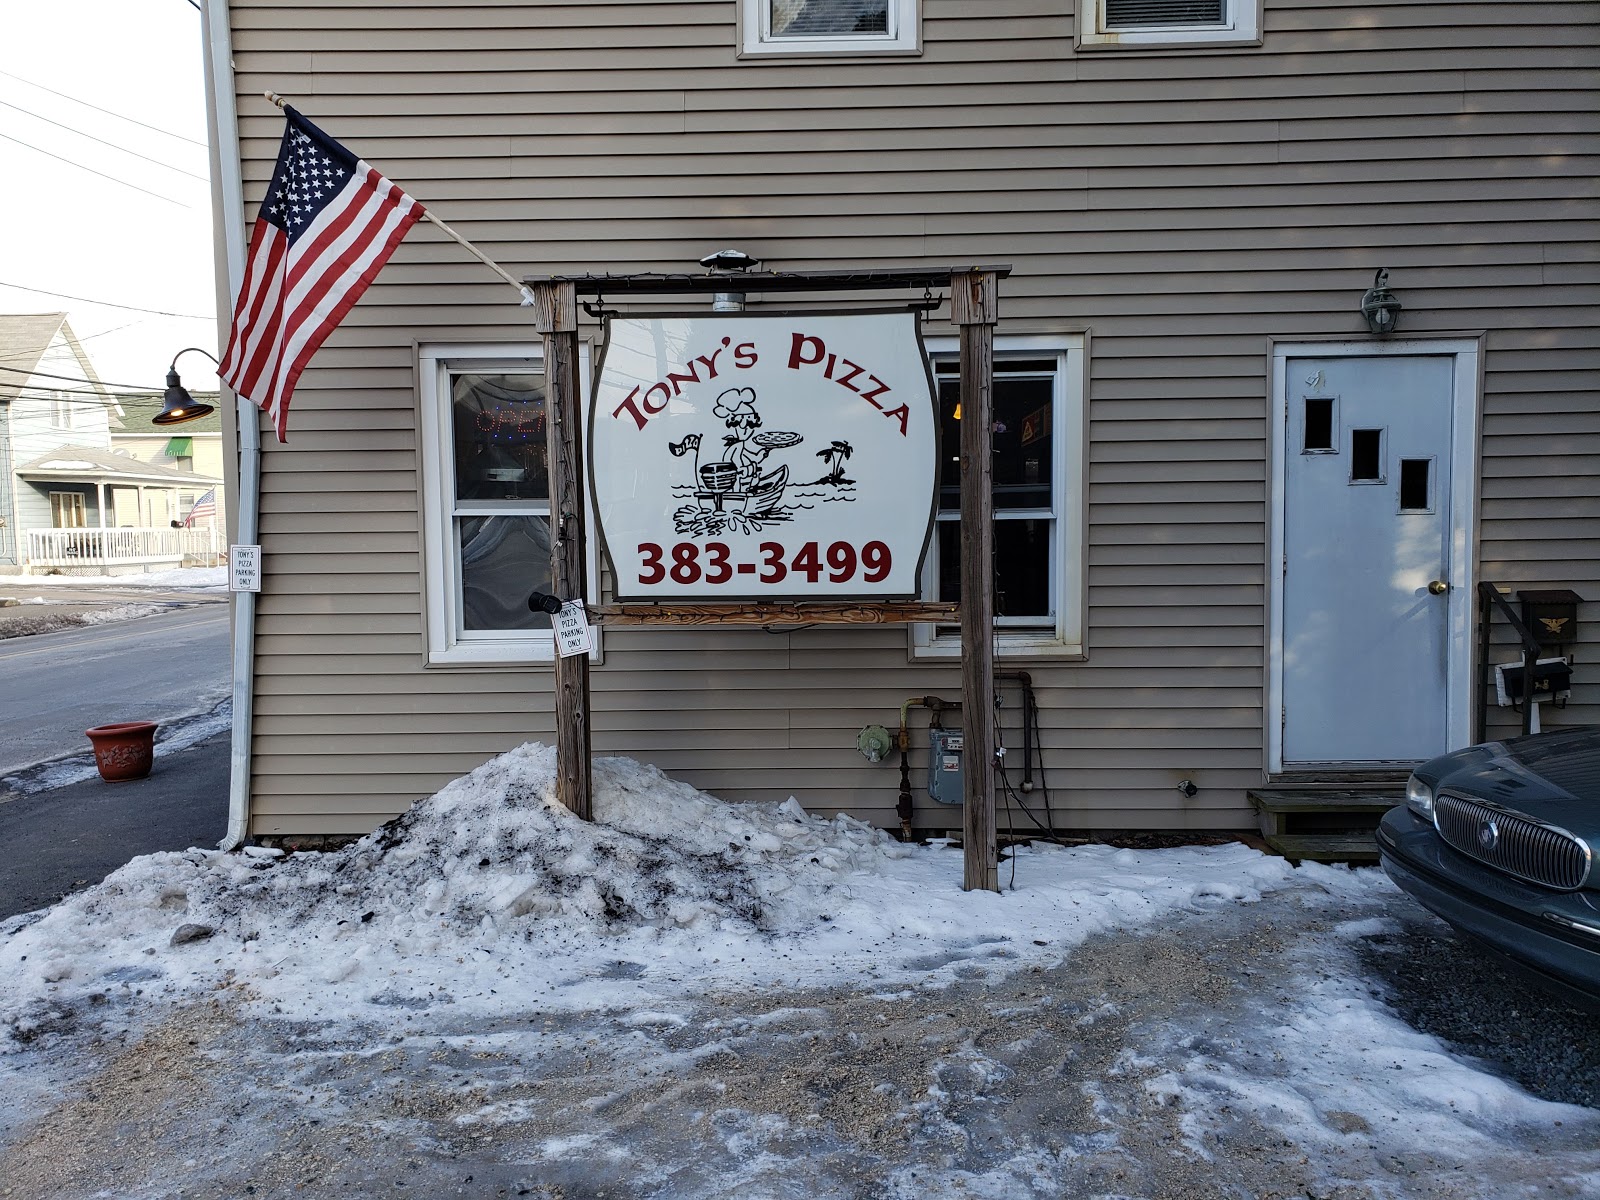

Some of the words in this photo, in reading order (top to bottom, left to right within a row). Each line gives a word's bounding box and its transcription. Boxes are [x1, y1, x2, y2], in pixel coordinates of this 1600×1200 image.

[787, 332, 910, 437] PIZZA
[476, 410, 546, 432] OPE
[637, 541, 892, 584] 383-3499
[561, 618, 578, 628] PIZZA
[560, 627, 583, 639] PARKING
[567, 638, 581, 648] ONLY
